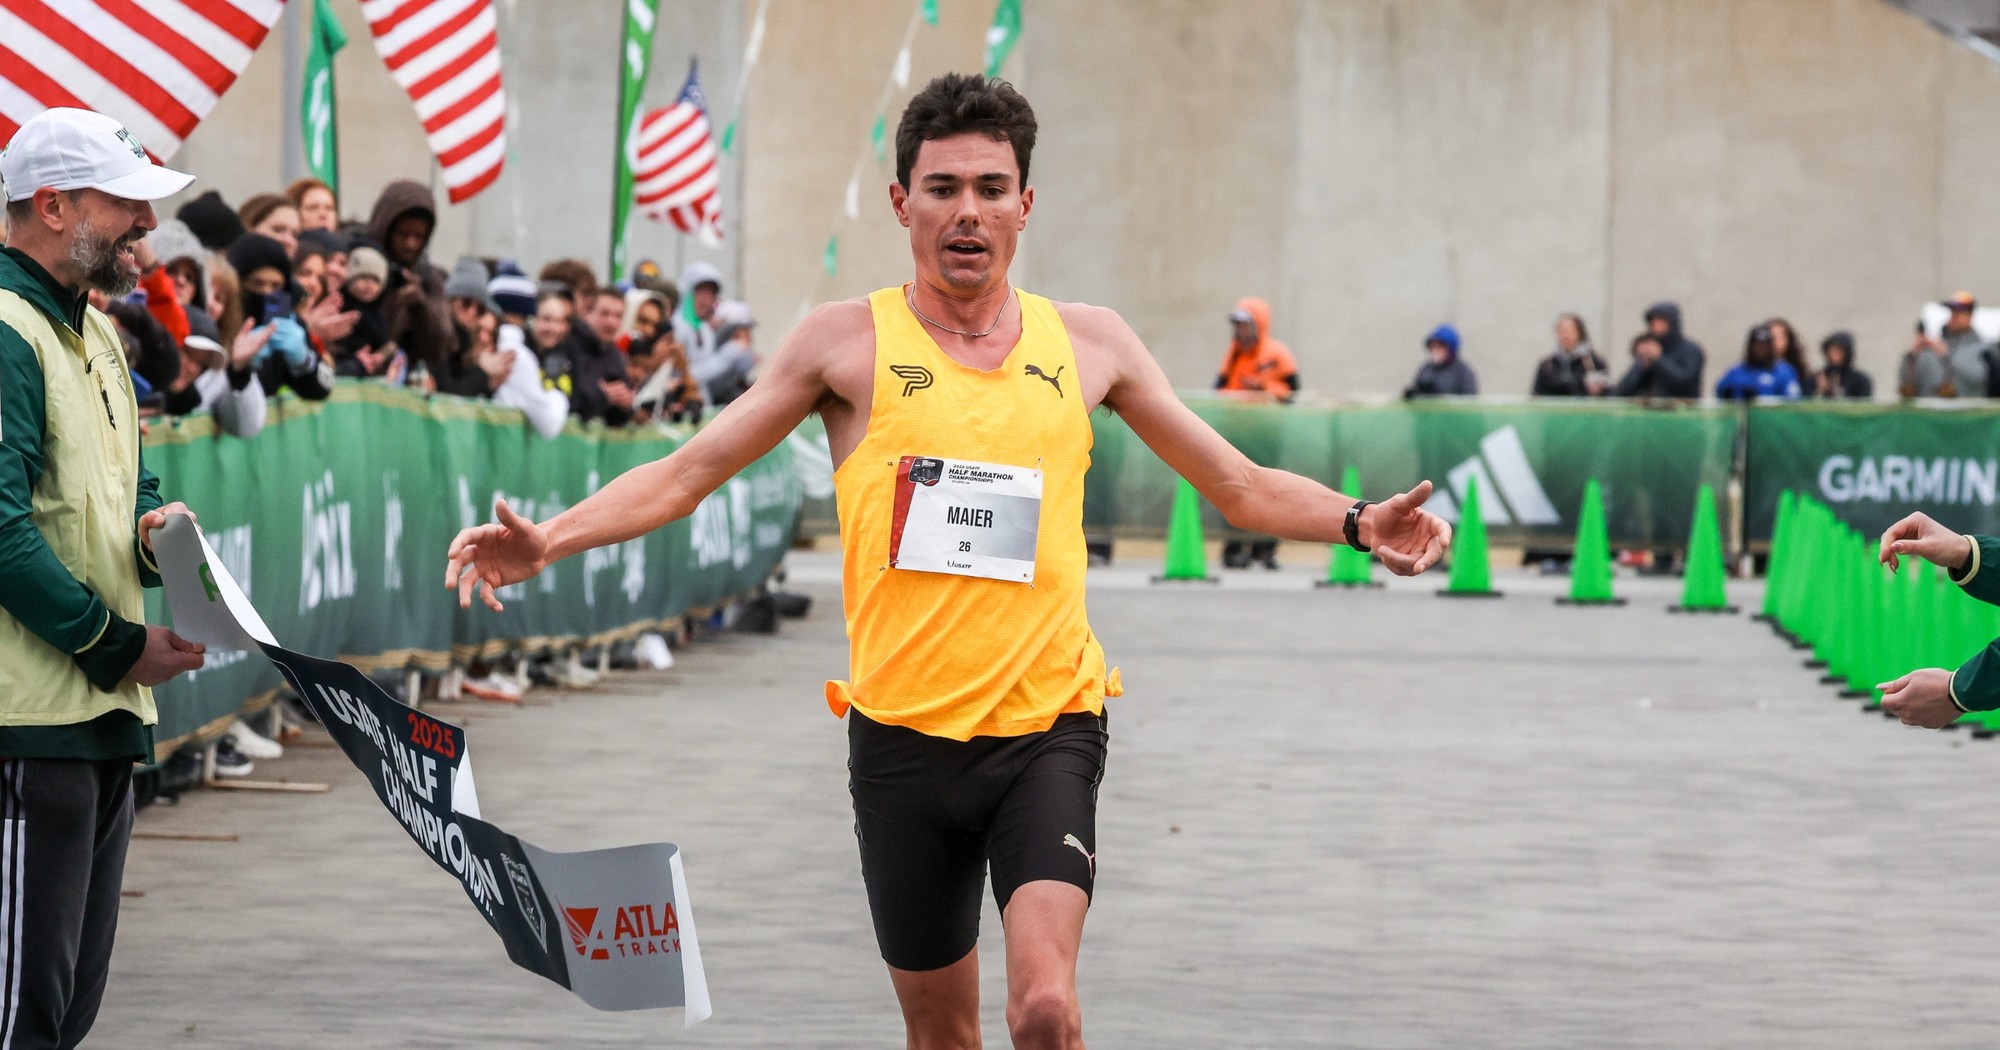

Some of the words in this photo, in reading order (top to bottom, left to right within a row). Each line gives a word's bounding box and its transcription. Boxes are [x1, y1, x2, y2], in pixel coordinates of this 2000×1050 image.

[948, 468, 969, 476] HALF
[970, 470, 1014, 481] MARATHON
[948, 474, 994, 484] CHAMPIONSHIPS
[1818, 454, 1998, 506] GARMIN
[947, 506, 993, 528] MAIER
[959, 541, 971, 552] 26
[315, 683, 388, 757] USATF
[386, 725, 438, 804] HALF
[407, 712, 456, 760] 2025
